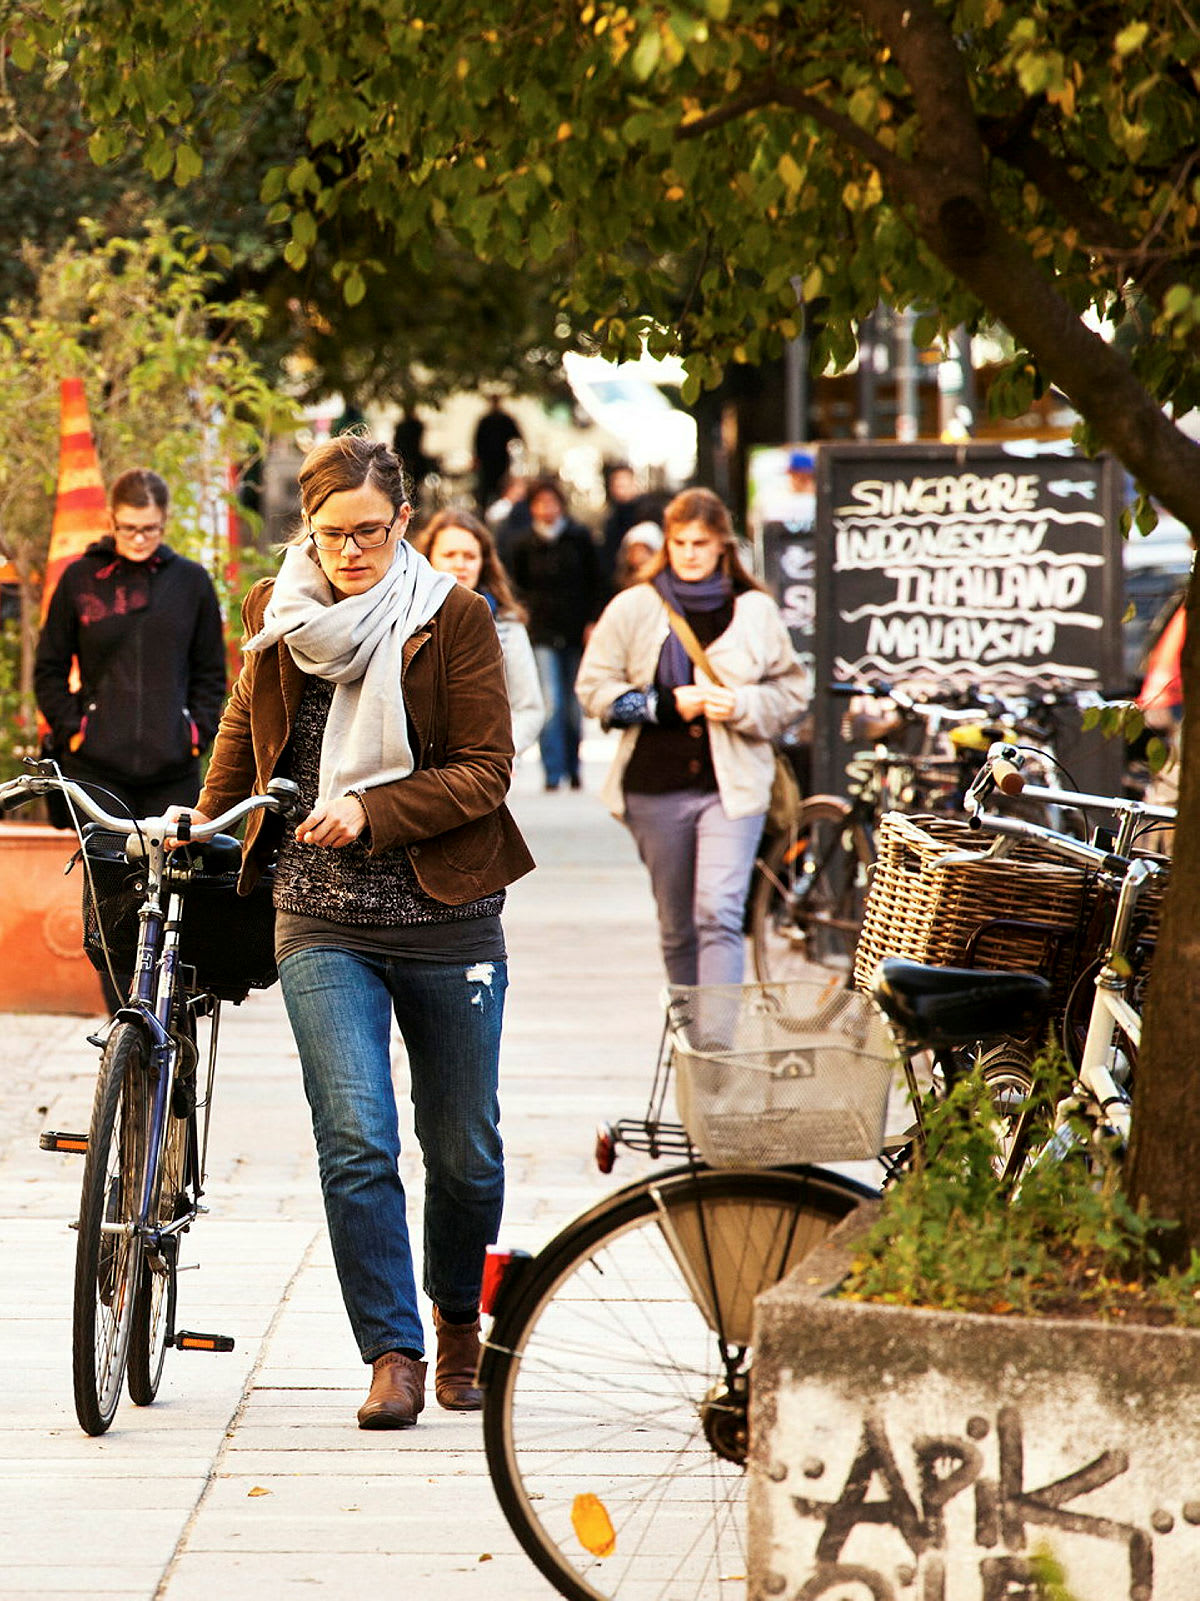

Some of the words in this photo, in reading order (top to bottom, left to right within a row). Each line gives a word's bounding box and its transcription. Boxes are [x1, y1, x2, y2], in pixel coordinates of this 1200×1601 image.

[834, 473, 1040, 516] SINGAPORE
[834, 521, 1049, 568] INDONESIEN
[885, 565, 1087, 609] THAILAND
[866, 615, 1056, 661] MALAYSIA
